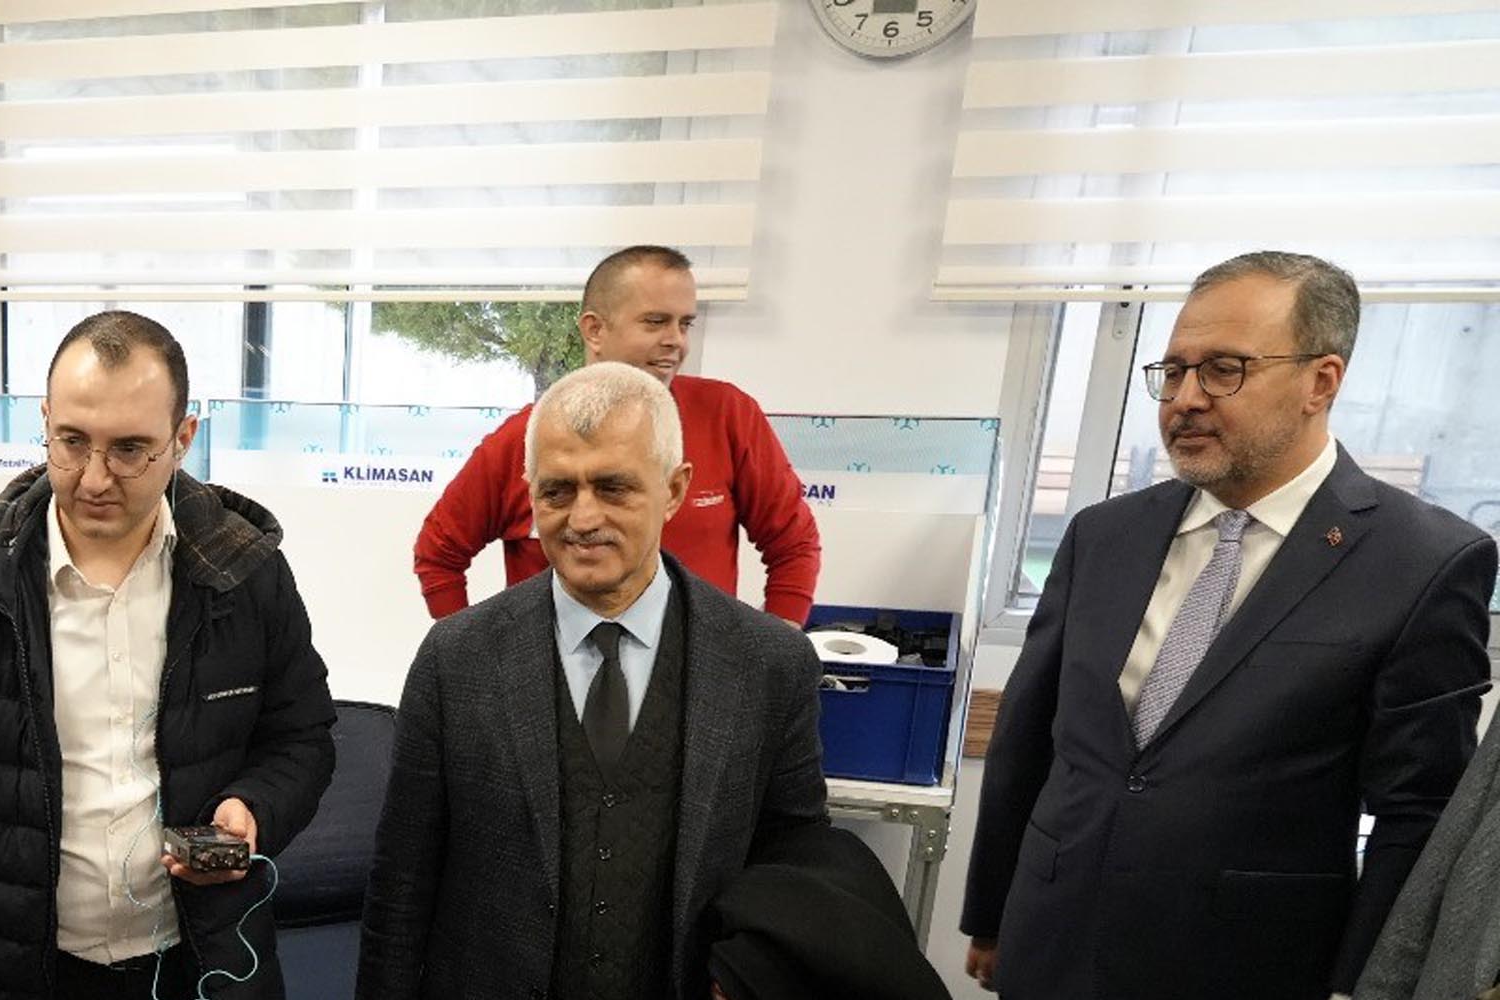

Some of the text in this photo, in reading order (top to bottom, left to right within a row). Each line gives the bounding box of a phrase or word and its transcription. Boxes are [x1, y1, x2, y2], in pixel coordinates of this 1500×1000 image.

[854, 13, 869, 31] 7
[916, 11, 933, 27] 5
[882, 21, 899, 38] 6
[343, 464, 433, 482] KLİMASAN
